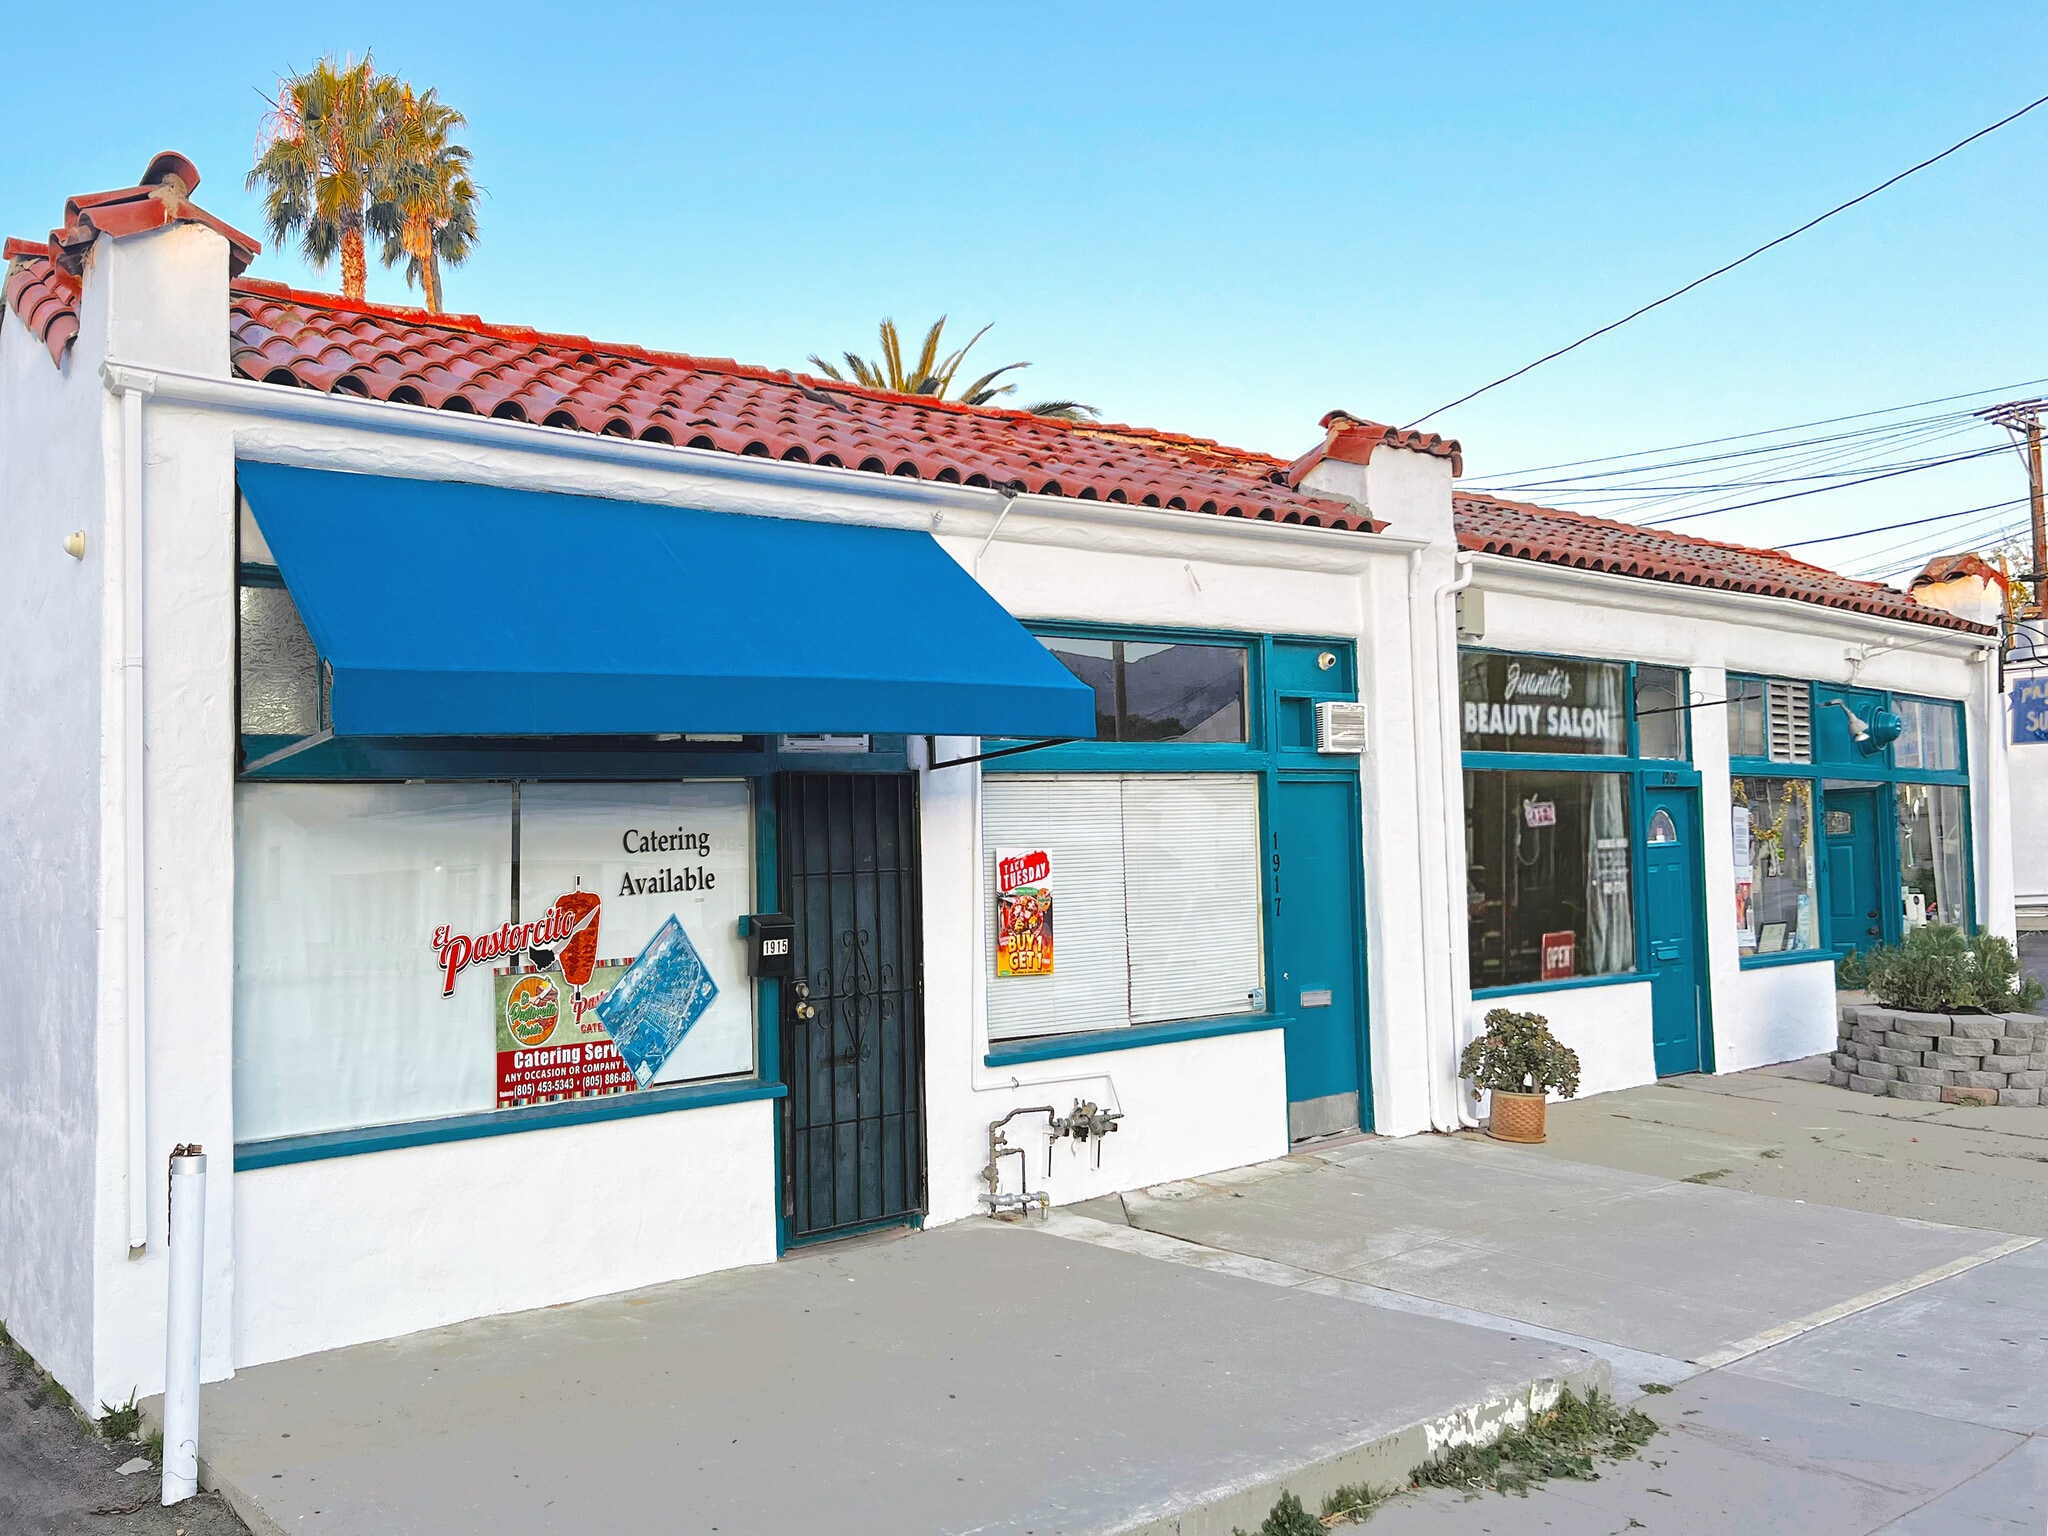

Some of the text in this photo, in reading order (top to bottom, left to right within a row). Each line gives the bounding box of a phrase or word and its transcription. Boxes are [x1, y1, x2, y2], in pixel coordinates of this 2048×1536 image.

[2022, 683, 2048, 703] PA
[1465, 701, 1609, 738] BEAUTY SALON
[622, 827, 710, 857] Catering
[1003, 860, 1025, 874] TACO
[1003, 862, 1046, 889] TUESDAY
[1273, 832, 1282, 917] 1917
[619, 866, 715, 896] Available
[432, 924, 451, 948] El
[765, 940, 787, 954] 1915
[1008, 934, 1035, 952] BUY
[1036, 935, 1042, 952] 1
[438, 906, 576, 997] Pastorcito
[1010, 951, 1042, 970] GET 1
[580, 1022, 606, 1034] CATE
[514, 1046, 581, 1069] Catering
[505, 1072, 522, 1083] ANY
[524, 1068, 566, 1081] OCCASION
[569, 1064, 580, 1074] OR
[582, 1061, 621, 1073] COMPANY
[514, 1081, 535, 1098] (805)
[537, 1077, 575, 1093] 453-5343
[582, 1073, 603, 1088] (805)
[604, 1070, 635, 1085] 886-887
